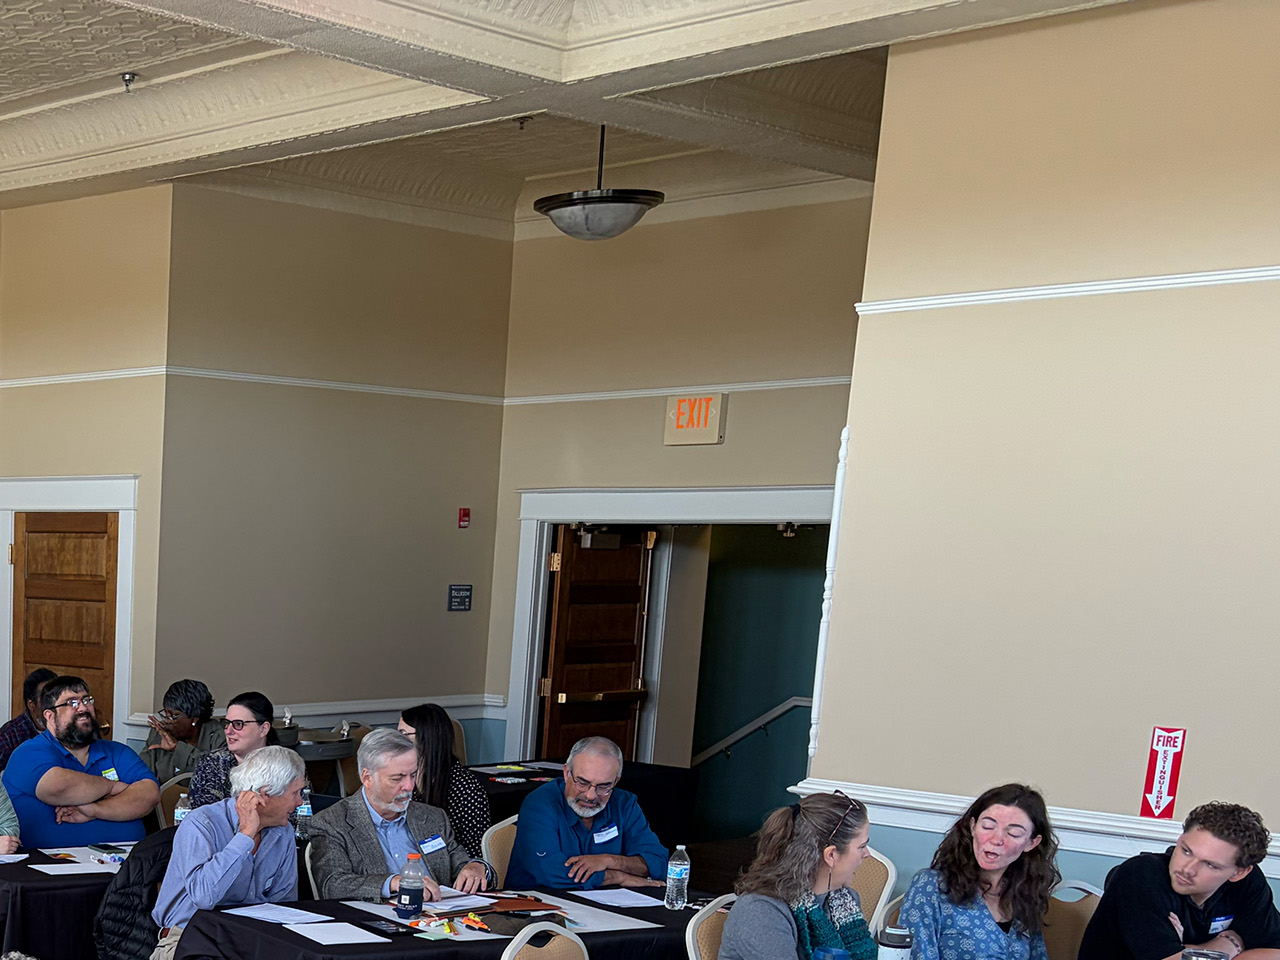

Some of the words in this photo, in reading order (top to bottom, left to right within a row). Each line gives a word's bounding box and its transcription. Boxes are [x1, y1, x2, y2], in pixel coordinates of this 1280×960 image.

[675, 397, 713, 429] EXIT
[1155, 734, 1180, 748] FIRE
[1154, 749, 1169, 810] EXTINGUISHER
